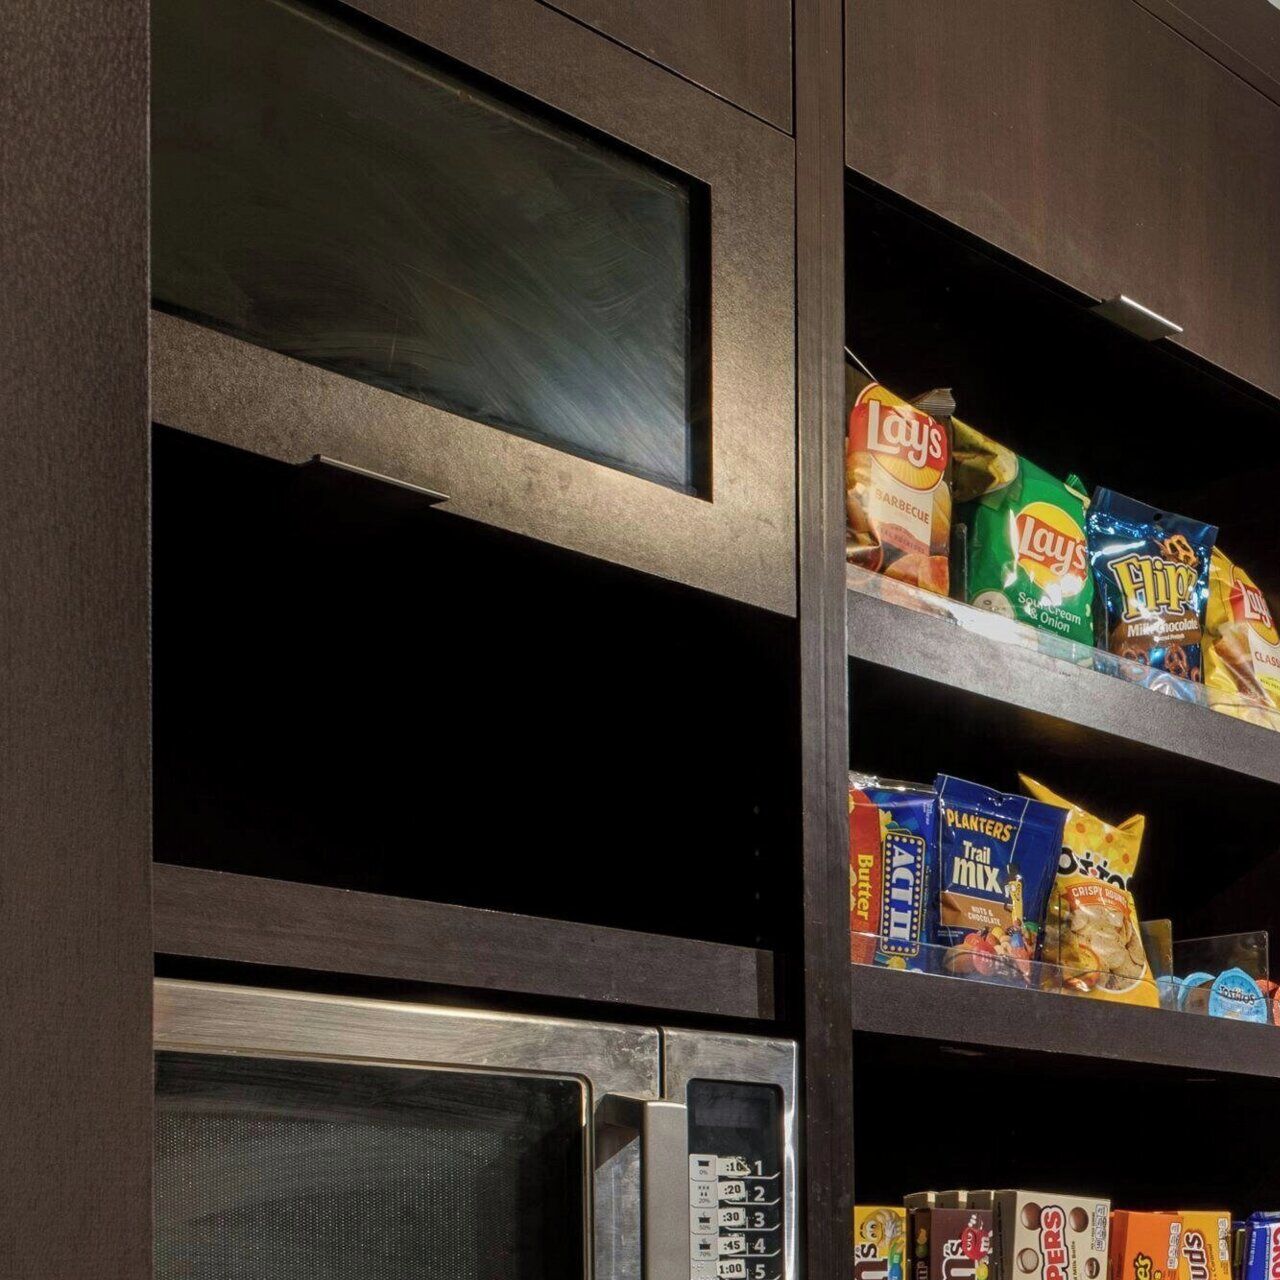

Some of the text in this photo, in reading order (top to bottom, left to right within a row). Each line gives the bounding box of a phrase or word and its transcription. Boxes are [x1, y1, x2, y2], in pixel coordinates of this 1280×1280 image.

[867, 400, 942, 468] Lay's
[875, 488, 930, 525] BARBECUE
[1018, 516, 1086, 577] Lay's
[1040, 612, 1070, 633] Onion
[1049, 604, 1082, 626] Cream
[946, 808, 1012, 843] PLANTERS
[962, 840, 991, 863] Trail
[952, 856, 1003, 895] mix
[857, 854, 874, 921] Butter
[890, 844, 915, 941] ACT II
[754, 1160, 763, 1176] 1
[754, 1186, 766, 1202] 2
[722, 1212, 740, 1222] :30
[754, 1212, 765, 1228] 3
[723, 1240, 741, 1250] :45
[754, 1238, 766, 1253] 4
[719, 1263, 743, 1274] 1:00
[755, 1264, 766, 1280] 5
